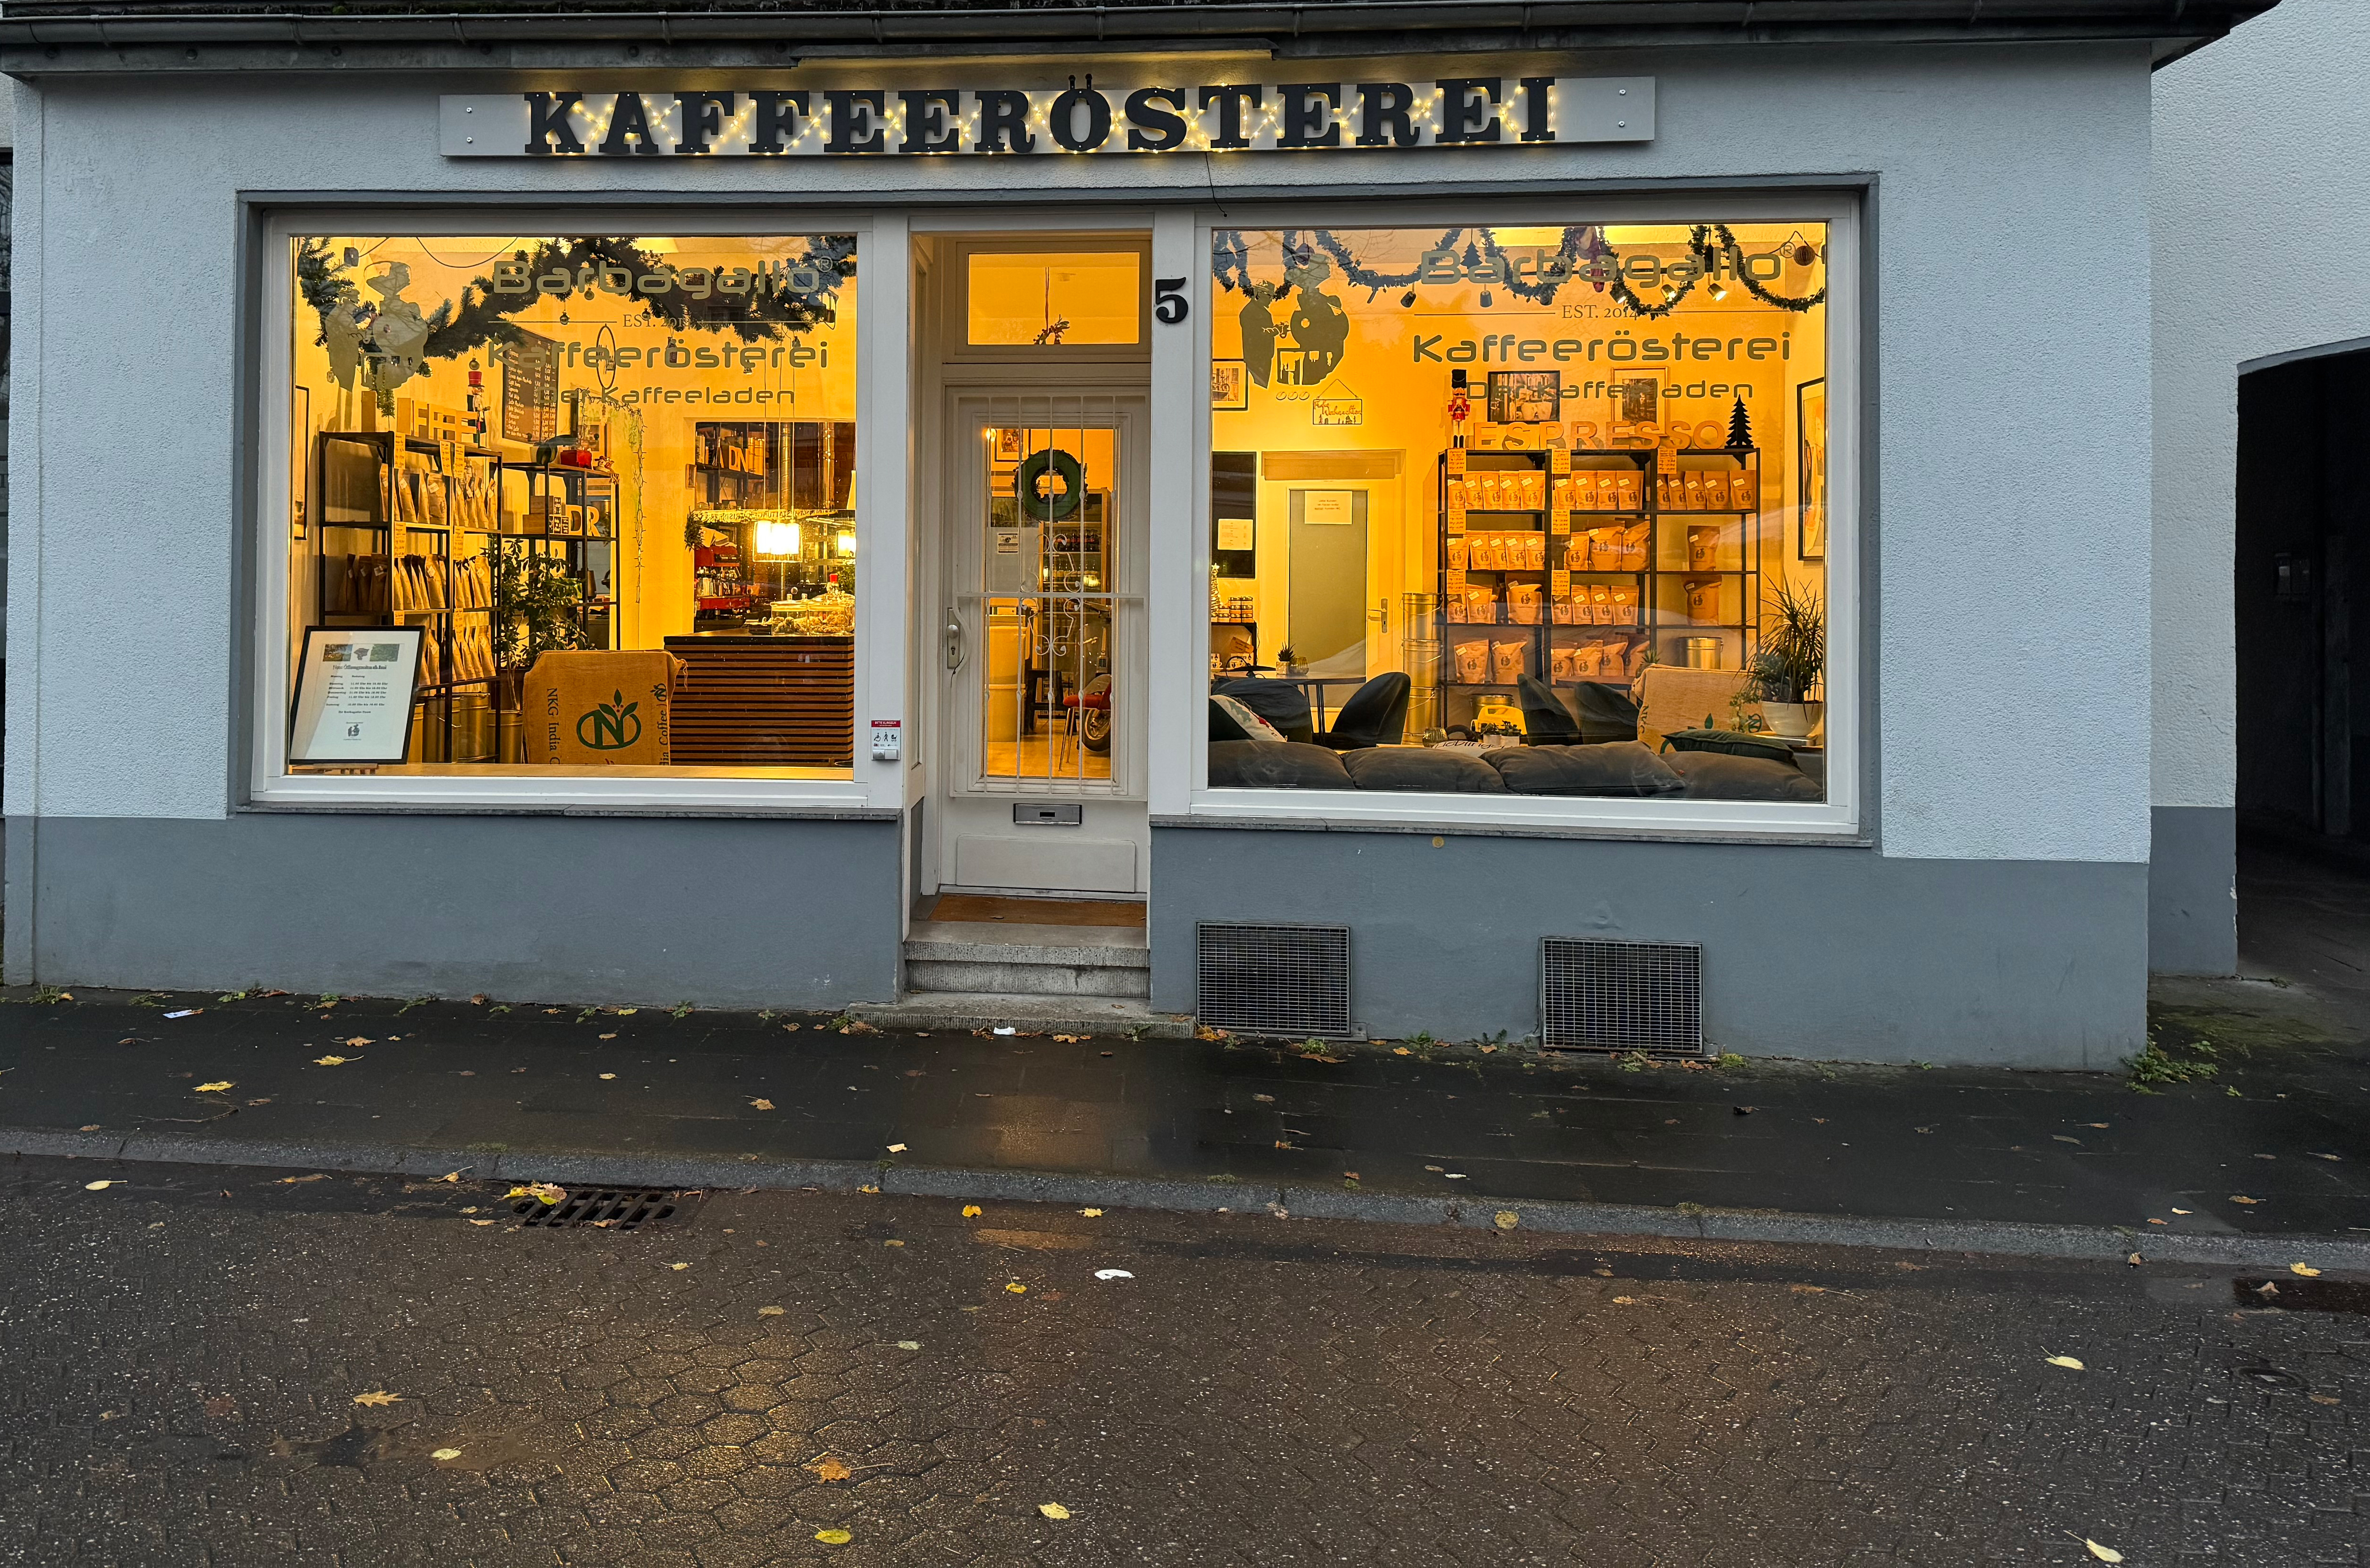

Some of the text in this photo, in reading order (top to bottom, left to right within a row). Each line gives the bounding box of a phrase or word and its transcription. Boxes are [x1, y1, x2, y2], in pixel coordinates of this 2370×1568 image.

[524, 74, 1555, 153] KAFFEERÖSTEREI
[494, 260, 819, 300] Barbagallo
[1421, 246, 1781, 288] Barbagallo
[1156, 277, 1188, 323] 5
[1562, 304, 1638, 321] EST. 2014
[488, 340, 828, 369] Kaffeerösterei
[1414, 330, 1790, 362] Kaffeerösterei
[601, 386, 795, 404] Kaffeeladen
[1474, 420, 1725, 451] ESPRESSO
[547, 688, 559, 716] NKG
[548, 722, 561, 751] India
[657, 710, 668, 746] Coffee
